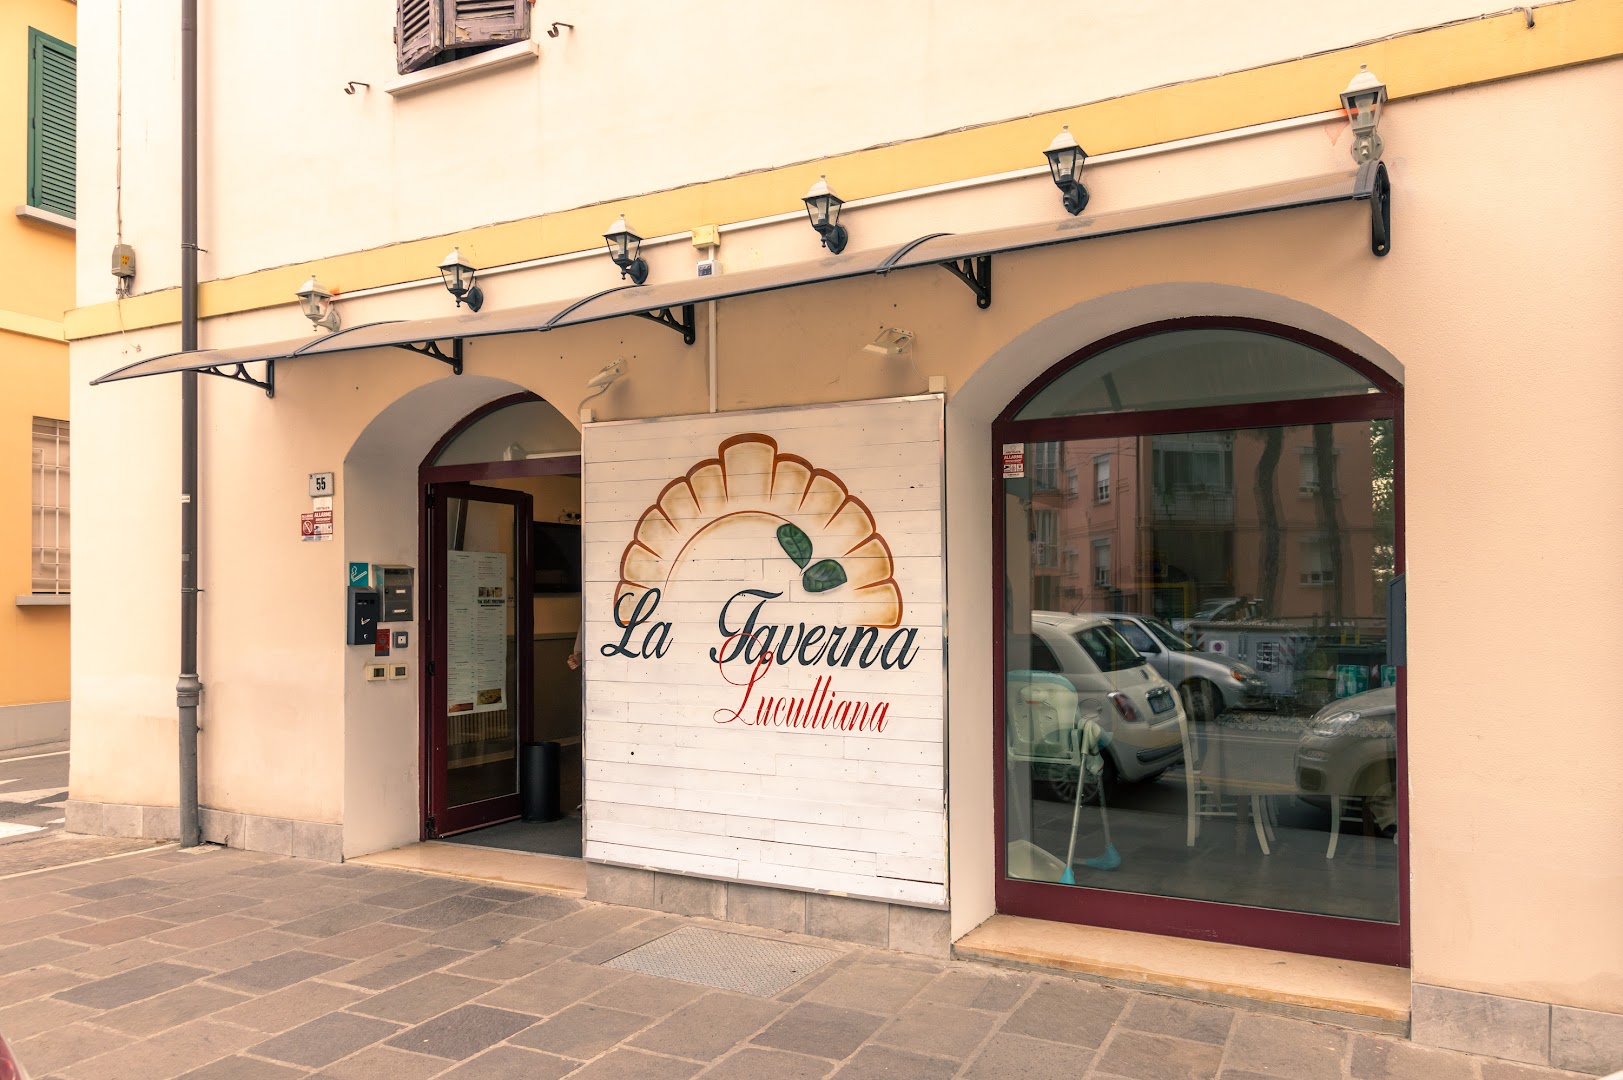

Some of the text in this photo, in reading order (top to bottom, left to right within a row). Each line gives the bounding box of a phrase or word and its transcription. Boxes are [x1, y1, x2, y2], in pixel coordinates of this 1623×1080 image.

[316, 477, 326, 490] 55
[600, 587, 920, 670] La Taverna
[713, 633, 889, 732] Luculliana
